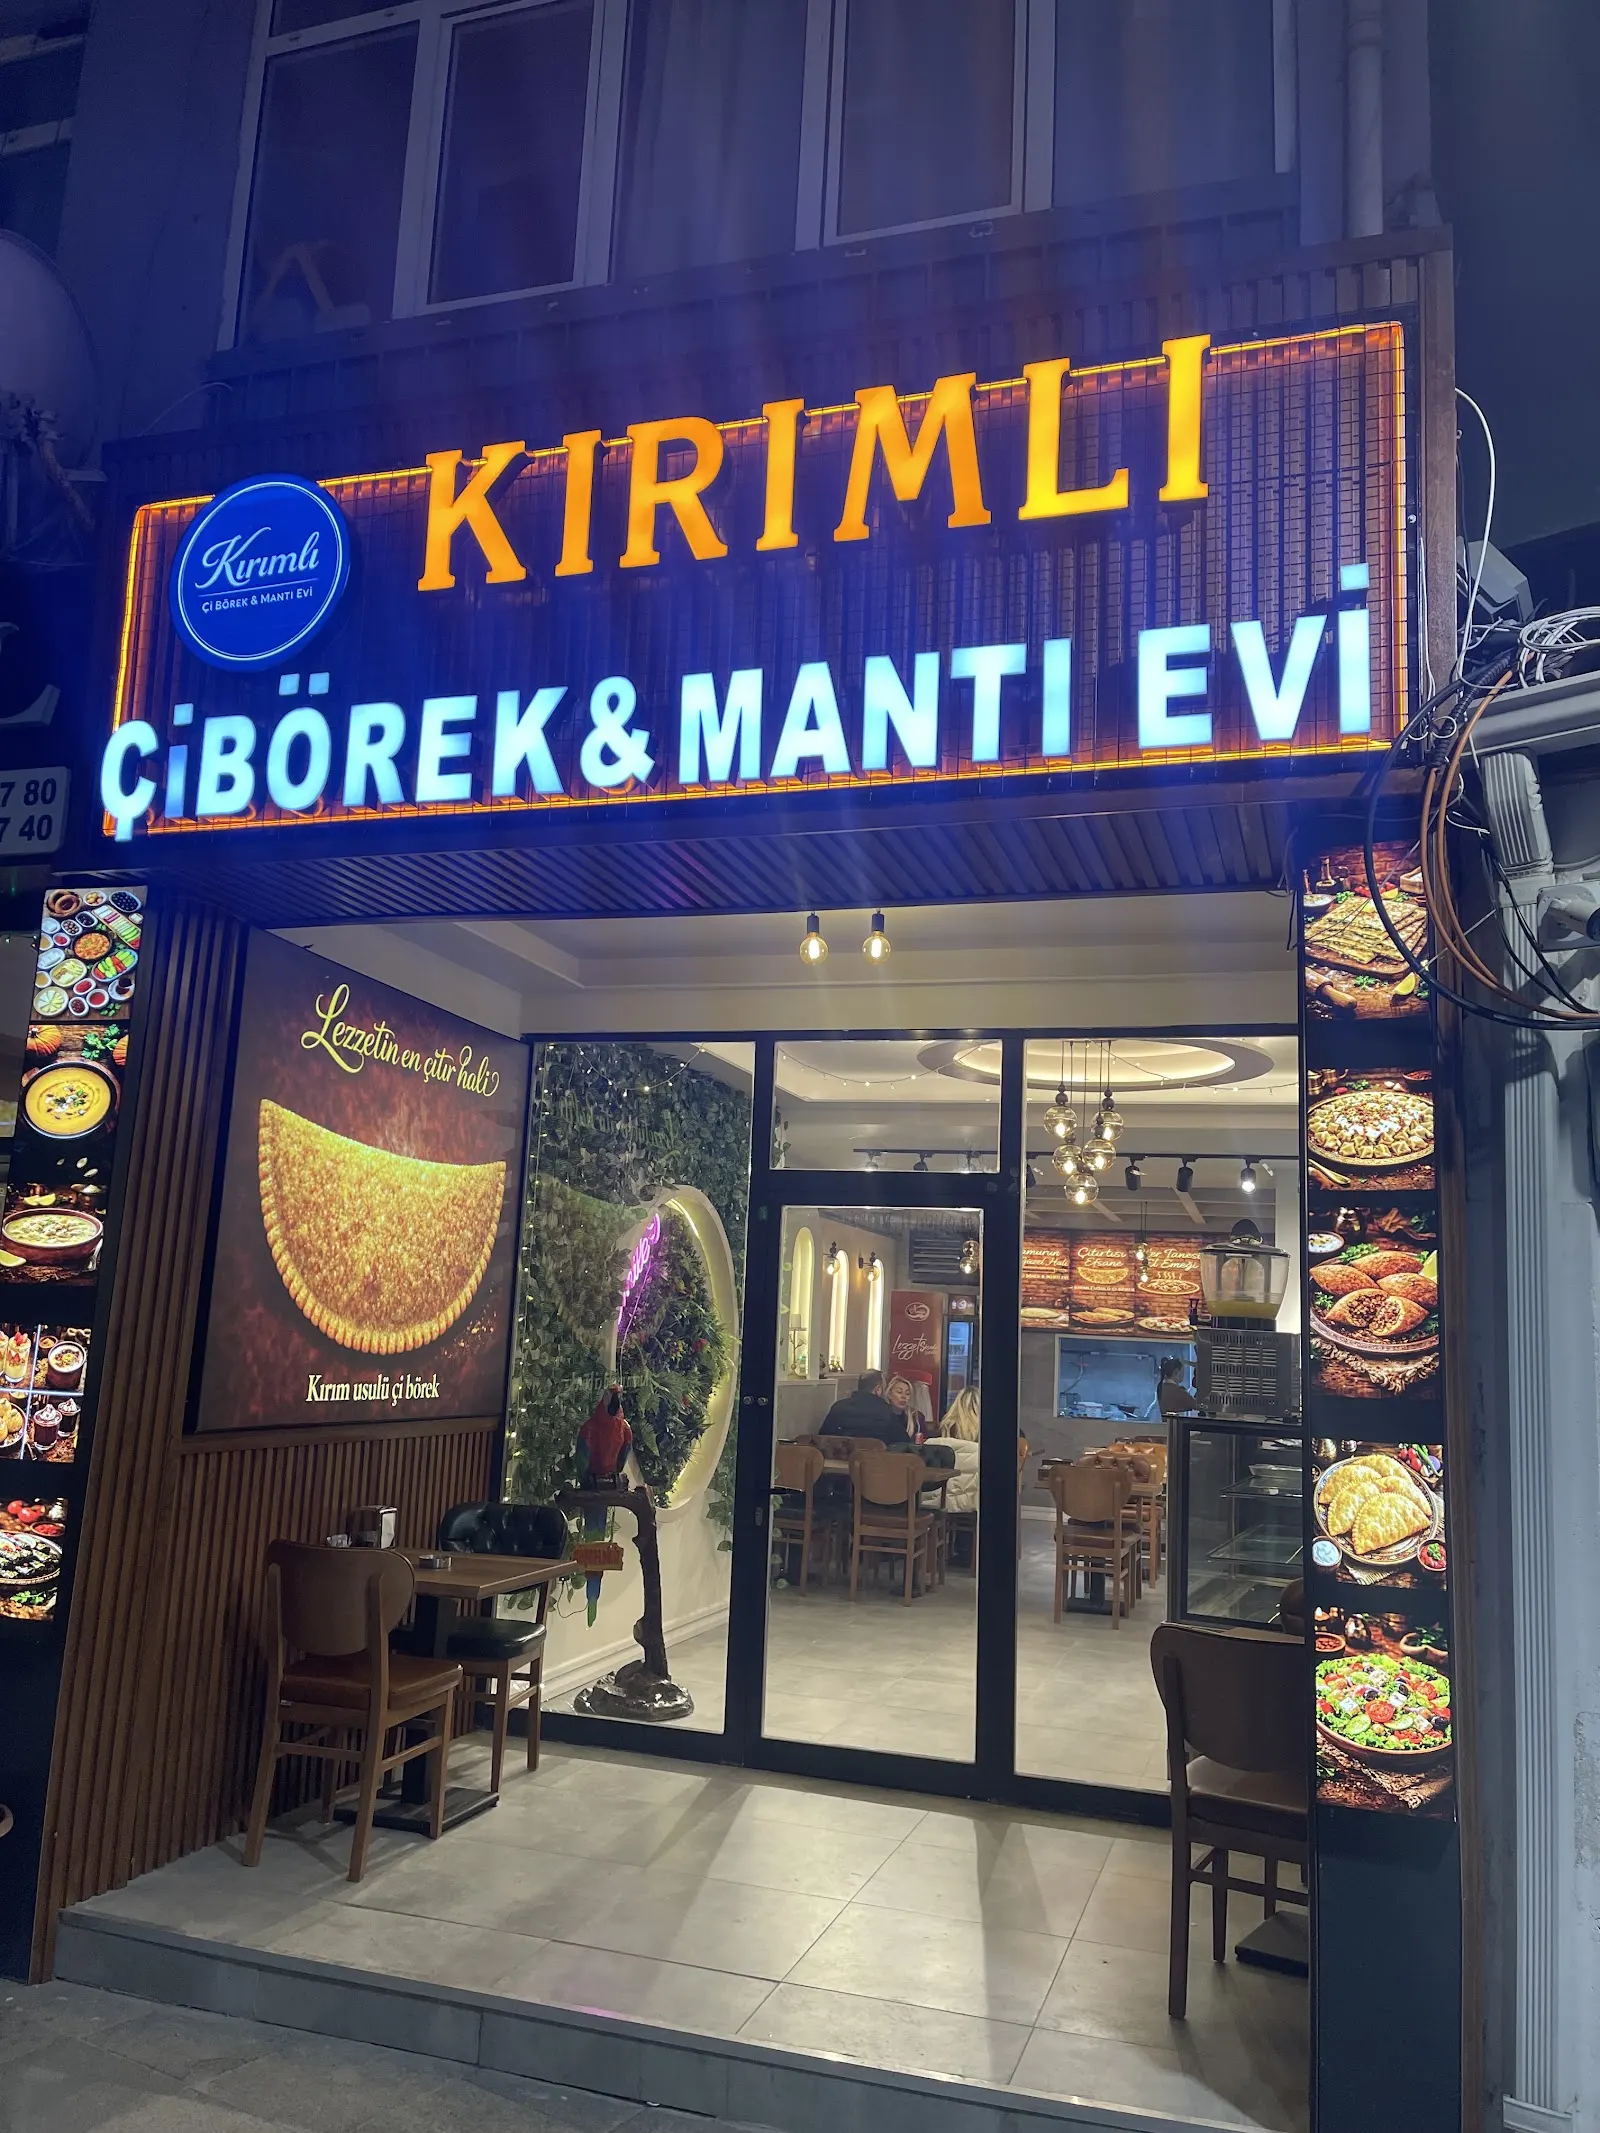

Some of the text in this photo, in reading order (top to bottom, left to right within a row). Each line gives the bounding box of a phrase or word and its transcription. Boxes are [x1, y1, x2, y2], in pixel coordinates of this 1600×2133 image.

[416, 333, 1212, 592] KIRIMLI
[195, 526, 320, 588] Kırımlı
[215, 597, 248, 610] BÖREK
[250, 595, 258, 605] &
[260, 591, 294, 603] MANTI
[579, 676, 656, 789] &
[679, 638, 1072, 785] MANTI
[23, 777, 57, 806] 80
[18, 814, 53, 842] 40
[301, 984, 500, 1097] Lezzetin en çıtır hali
[1084, 1257, 1124, 1267] Efsane
[305, 1373, 440, 1407] Kırım usulü çi börek
